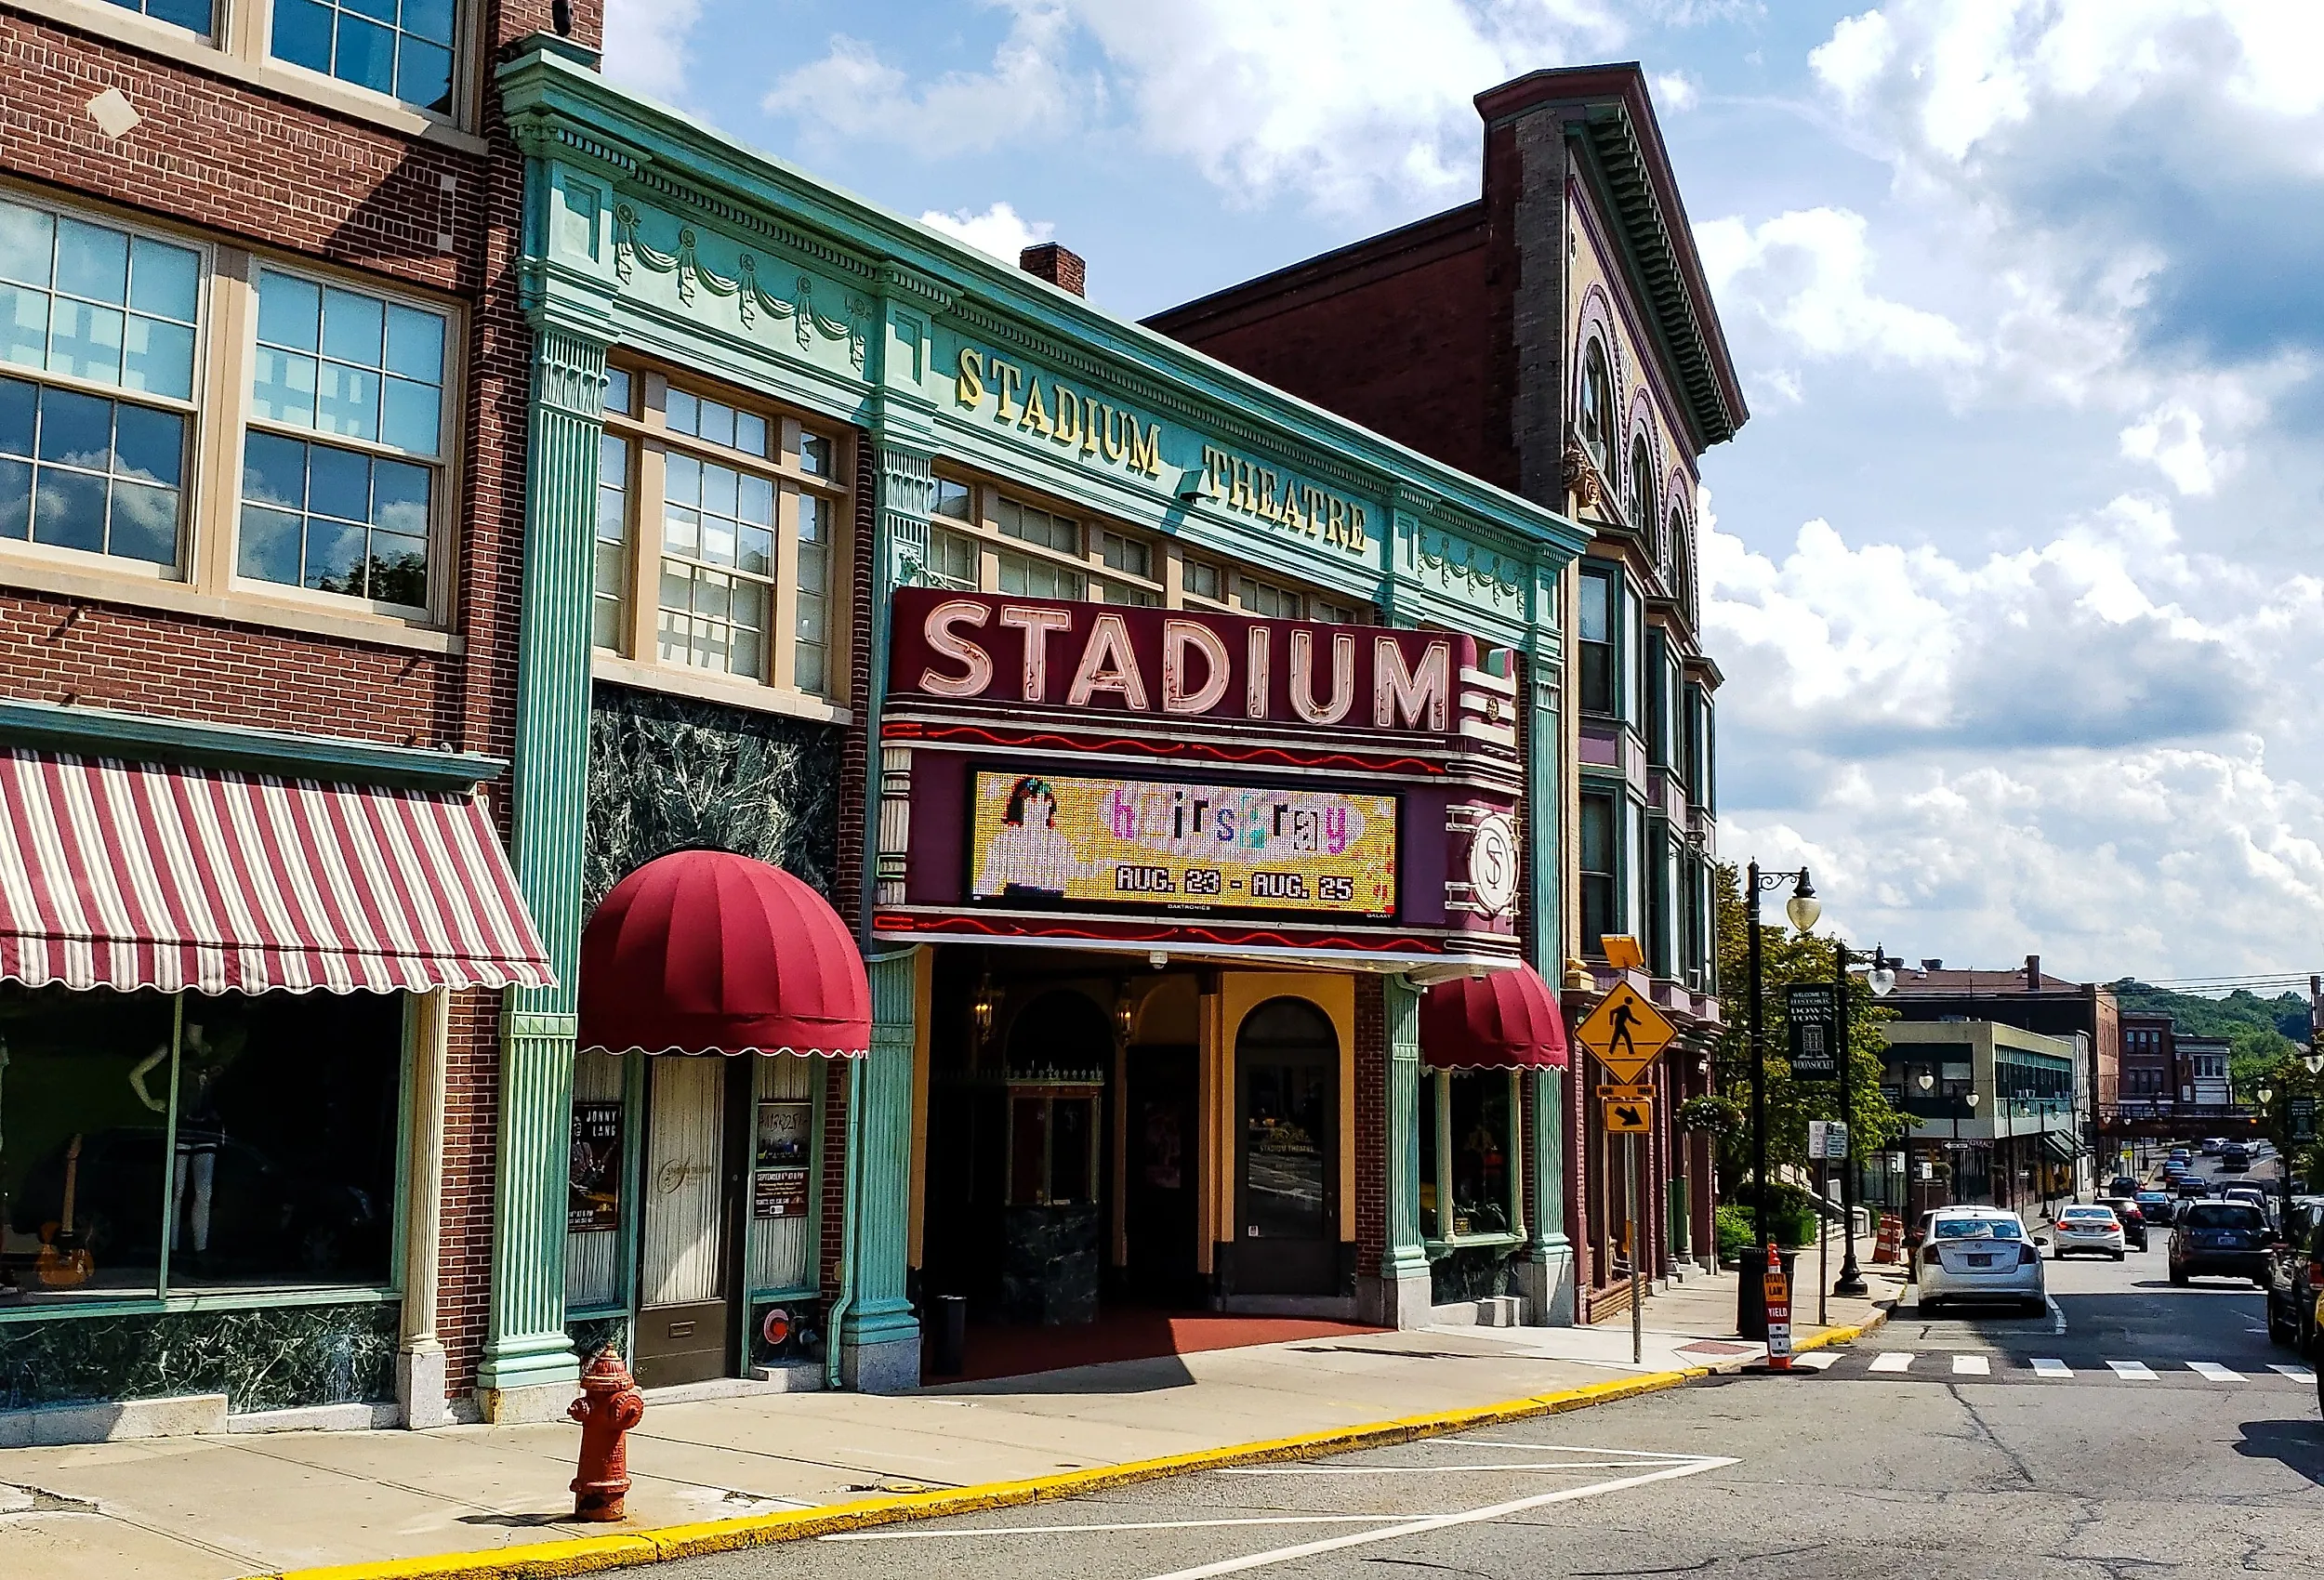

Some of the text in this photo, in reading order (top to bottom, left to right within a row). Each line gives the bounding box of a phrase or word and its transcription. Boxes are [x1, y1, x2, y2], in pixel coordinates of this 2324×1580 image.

[957, 347, 1367, 554] STADIUM THEATRE
[918, 598, 1451, 732] STADIUM
[1114, 790, 1347, 854] hirspray
[1117, 867, 1174, 892] AUG.
[1186, 869, 1220, 893] 23
[1253, 874, 1309, 898] AUG.
[1319, 876, 1353, 900] 25
[1792, 1060, 1834, 1070] WOONSOCKET
[587, 1110, 617, 1123] JONNY
[592, 1125, 616, 1137] LANG
[1768, 1285, 1783, 1296] LAW
[1768, 1307, 1788, 1317] YIELD
